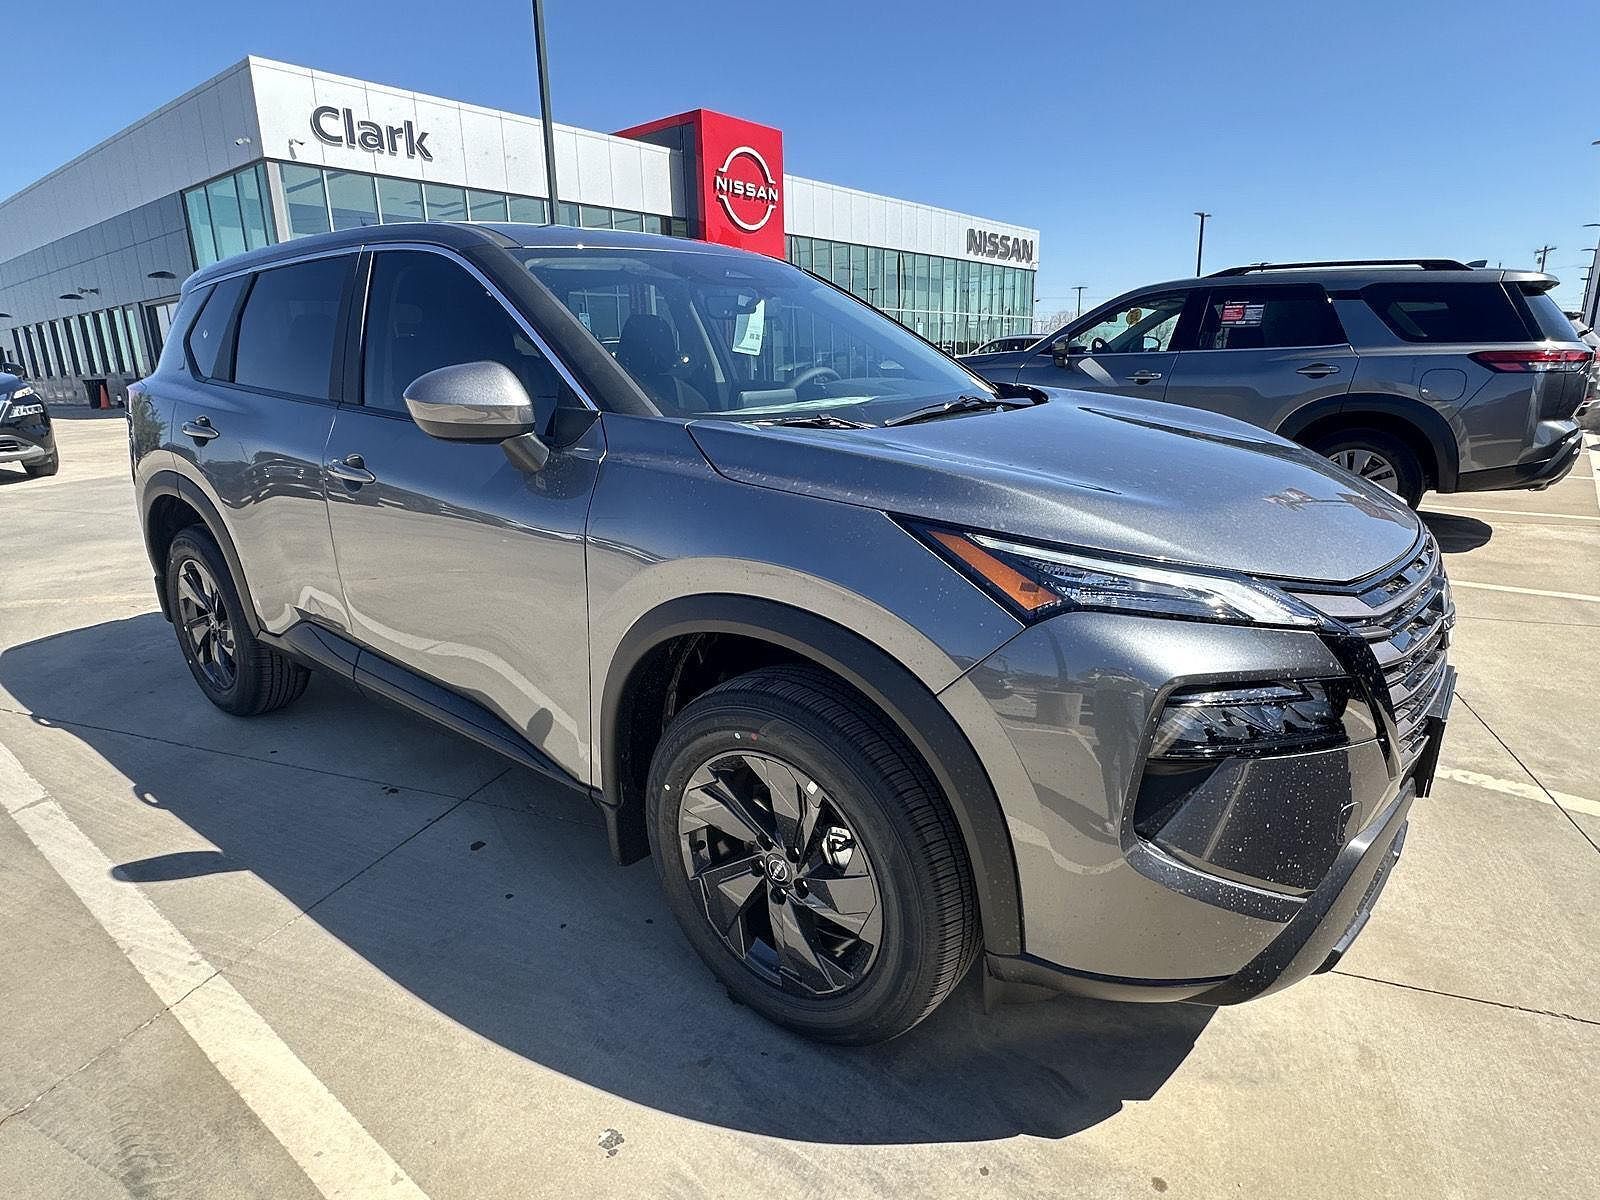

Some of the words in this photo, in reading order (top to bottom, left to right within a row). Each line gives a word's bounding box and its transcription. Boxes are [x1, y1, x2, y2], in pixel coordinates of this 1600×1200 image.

[310, 105, 433, 161] Clark
[715, 175, 779, 202] NISSAN
[966, 228, 1034, 263] NISSAN
